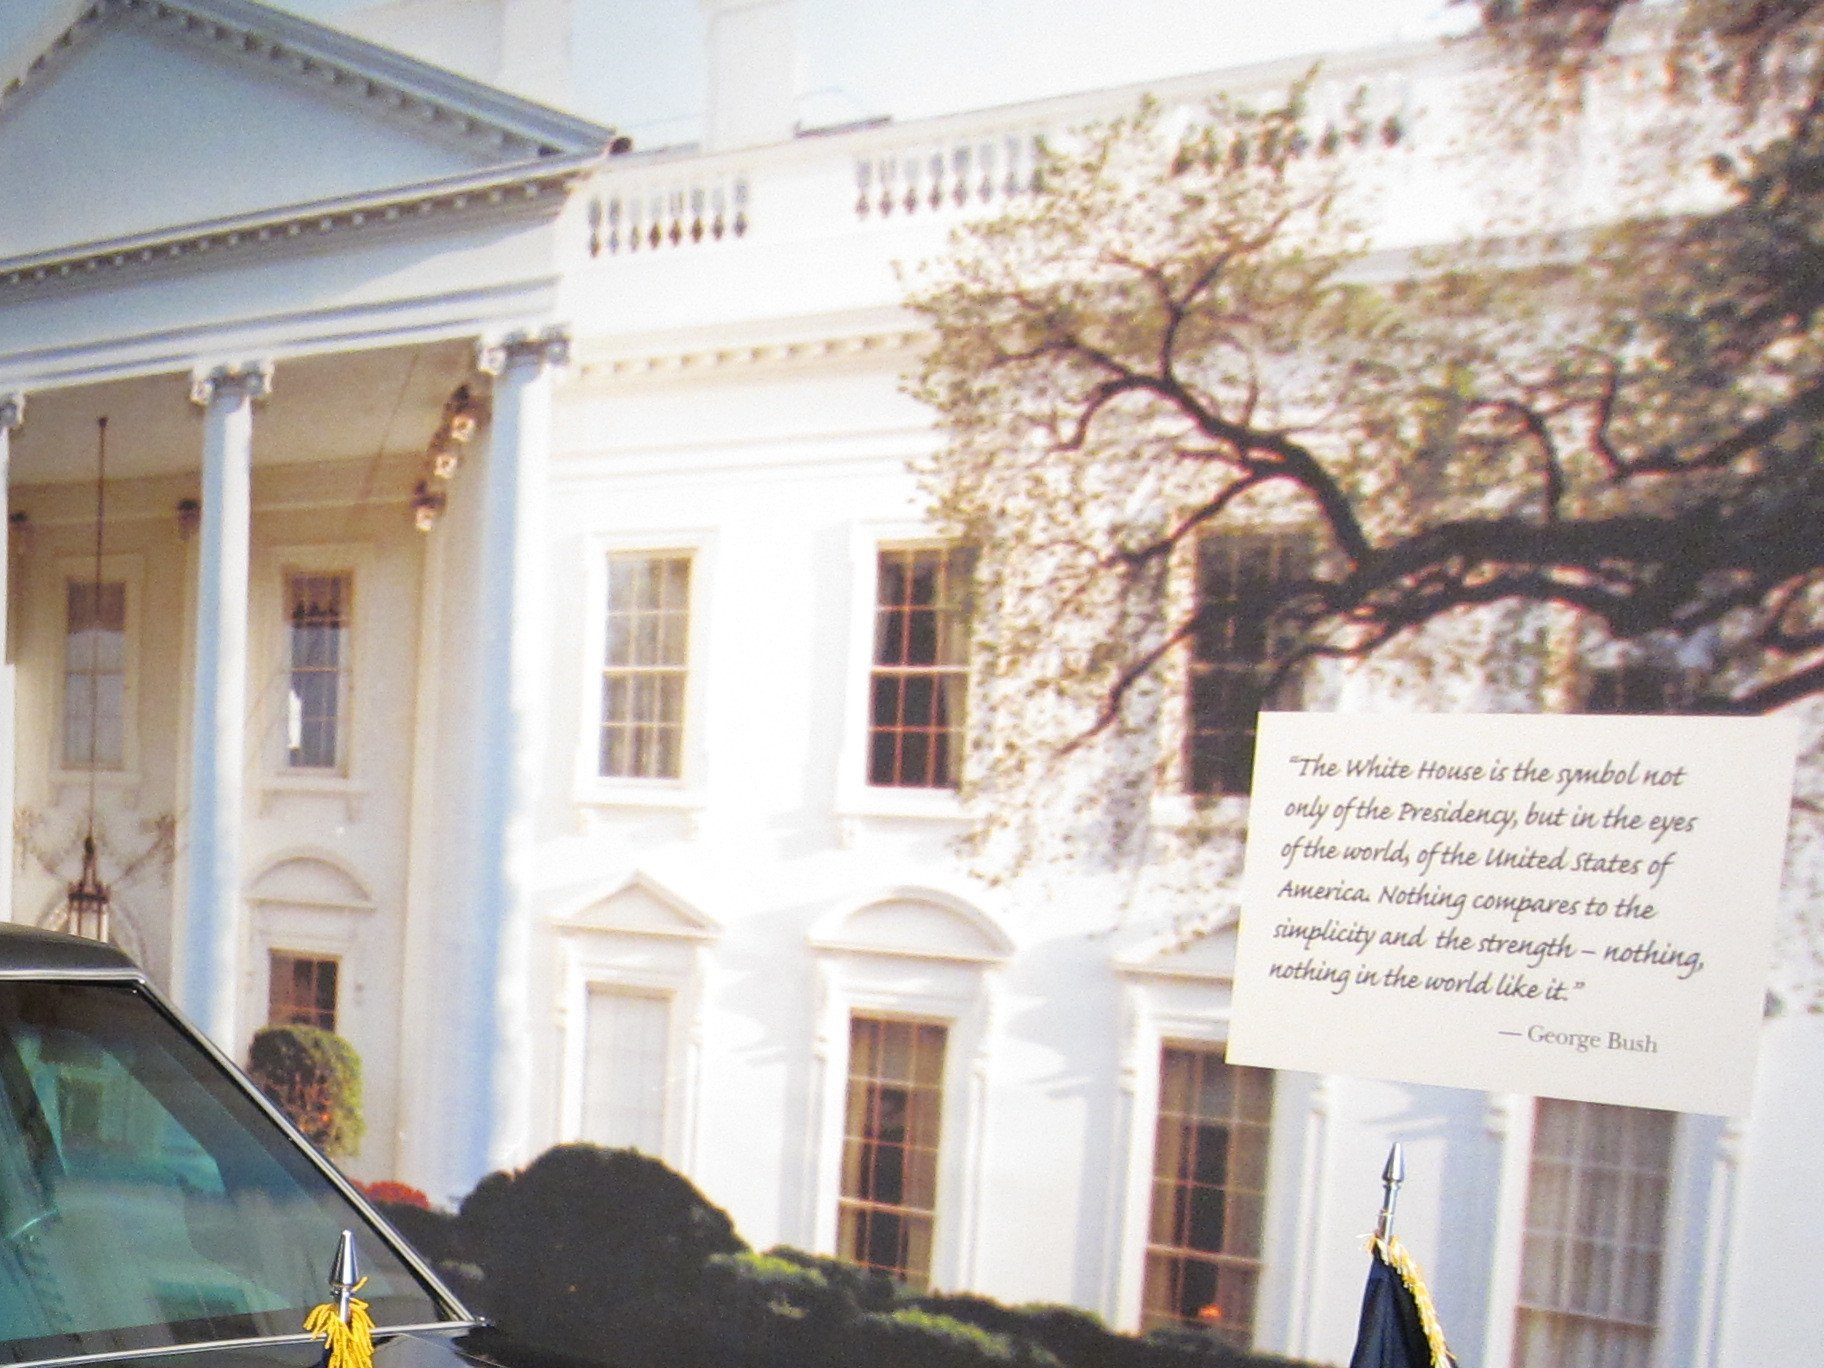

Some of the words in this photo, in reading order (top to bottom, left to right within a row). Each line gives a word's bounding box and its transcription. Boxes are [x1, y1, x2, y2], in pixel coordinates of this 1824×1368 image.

[1347, 755, 1412, 779] White
[1417, 760, 1484, 781] House
[1489, 759, 1508, 782] is
[1513, 758, 1551, 783] the
[1556, 759, 1639, 796] symbol
[1643, 767, 1687, 787] not
[1284, 795, 1328, 830] only
[1332, 796, 1358, 831] of
[1356, 797, 1392, 821] the
[1397, 800, 1518, 837] Presidency,
[1524, 801, 1567, 827] but
[1571, 804, 1597, 828] in
[1602, 804, 1644, 830] the
[1648, 815, 1699, 844] eyes
[1280, 835, 1305, 870] of
[1303, 836, 1340, 860] the
[1342, 839, 1410, 868] world,
[1416, 841, 1444, 877] of
[1441, 842, 1478, 866] the
[1484, 846, 1568, 870] United
[1570, 852, 1643, 875] States
[1647, 852, 1677, 890] of
[1277, 880, 1370, 903] America.
[1377, 883, 1467, 921] Nothing
[1472, 894, 1581, 923] compares
[1585, 897, 1608, 917] to
[1614, 894, 1659, 920] the
[1273, 917, 1376, 956] simplicity
[1379, 925, 1427, 948] and
[1434, 927, 1475, 951] the
[1477, 934, 1576, 969] strength
[1603, 940, 1705, 980] nothing,
[1268, 958, 1350, 995] nothing
[1354, 964, 1378, 987] in
[1383, 964, 1423, 990] the
[1425, 971, 1492, 994] world
[1496, 973, 1543, 999] like
[1527, 1024, 1602, 1053] George
[1607, 1031, 1658, 1054] Bush
